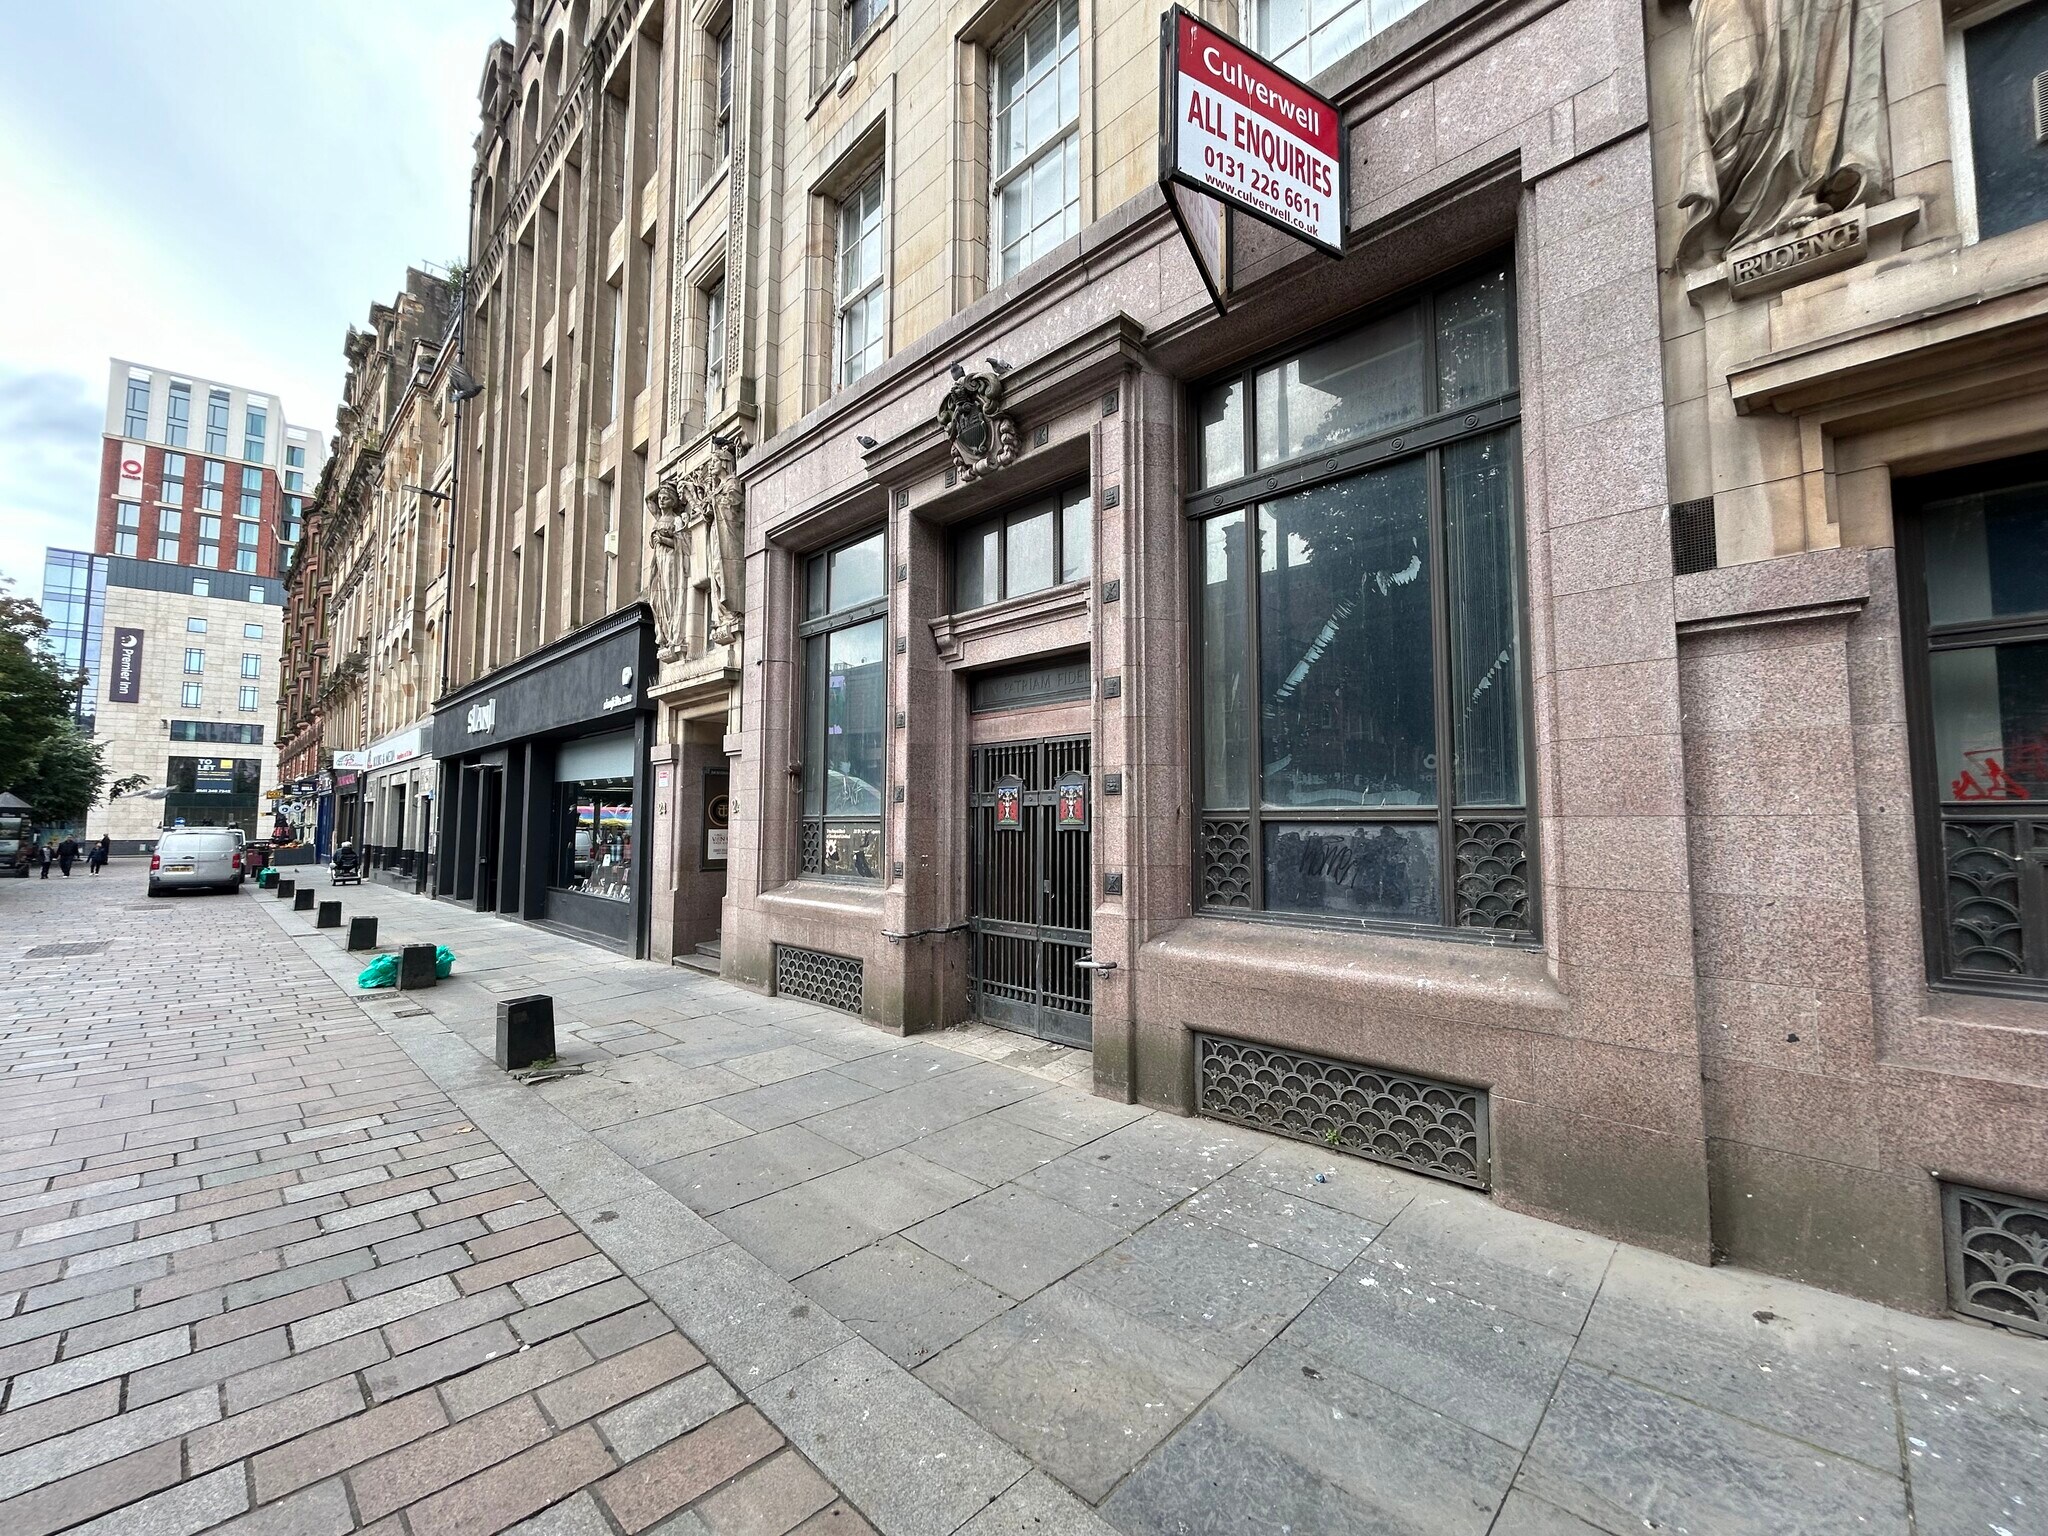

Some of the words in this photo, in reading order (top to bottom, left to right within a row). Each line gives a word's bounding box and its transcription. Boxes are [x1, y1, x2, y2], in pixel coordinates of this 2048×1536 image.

[1203, 47, 1320, 137] Culverwell
[1187, 90, 1228, 141] ALL
[1234, 114, 1332, 198] ENQUIRIES
[1204, 145, 1244, 183] 0131
[1250, 169, 1280, 201] 226
[1284, 187, 1320, 222] 6611
[1205, 171, 1319, 237] www.culverwell.co.uk
[119, 681, 131, 694] Inn
[120, 648, 134, 681] Premier
[1004, 674, 1051, 694] PATRIAM
